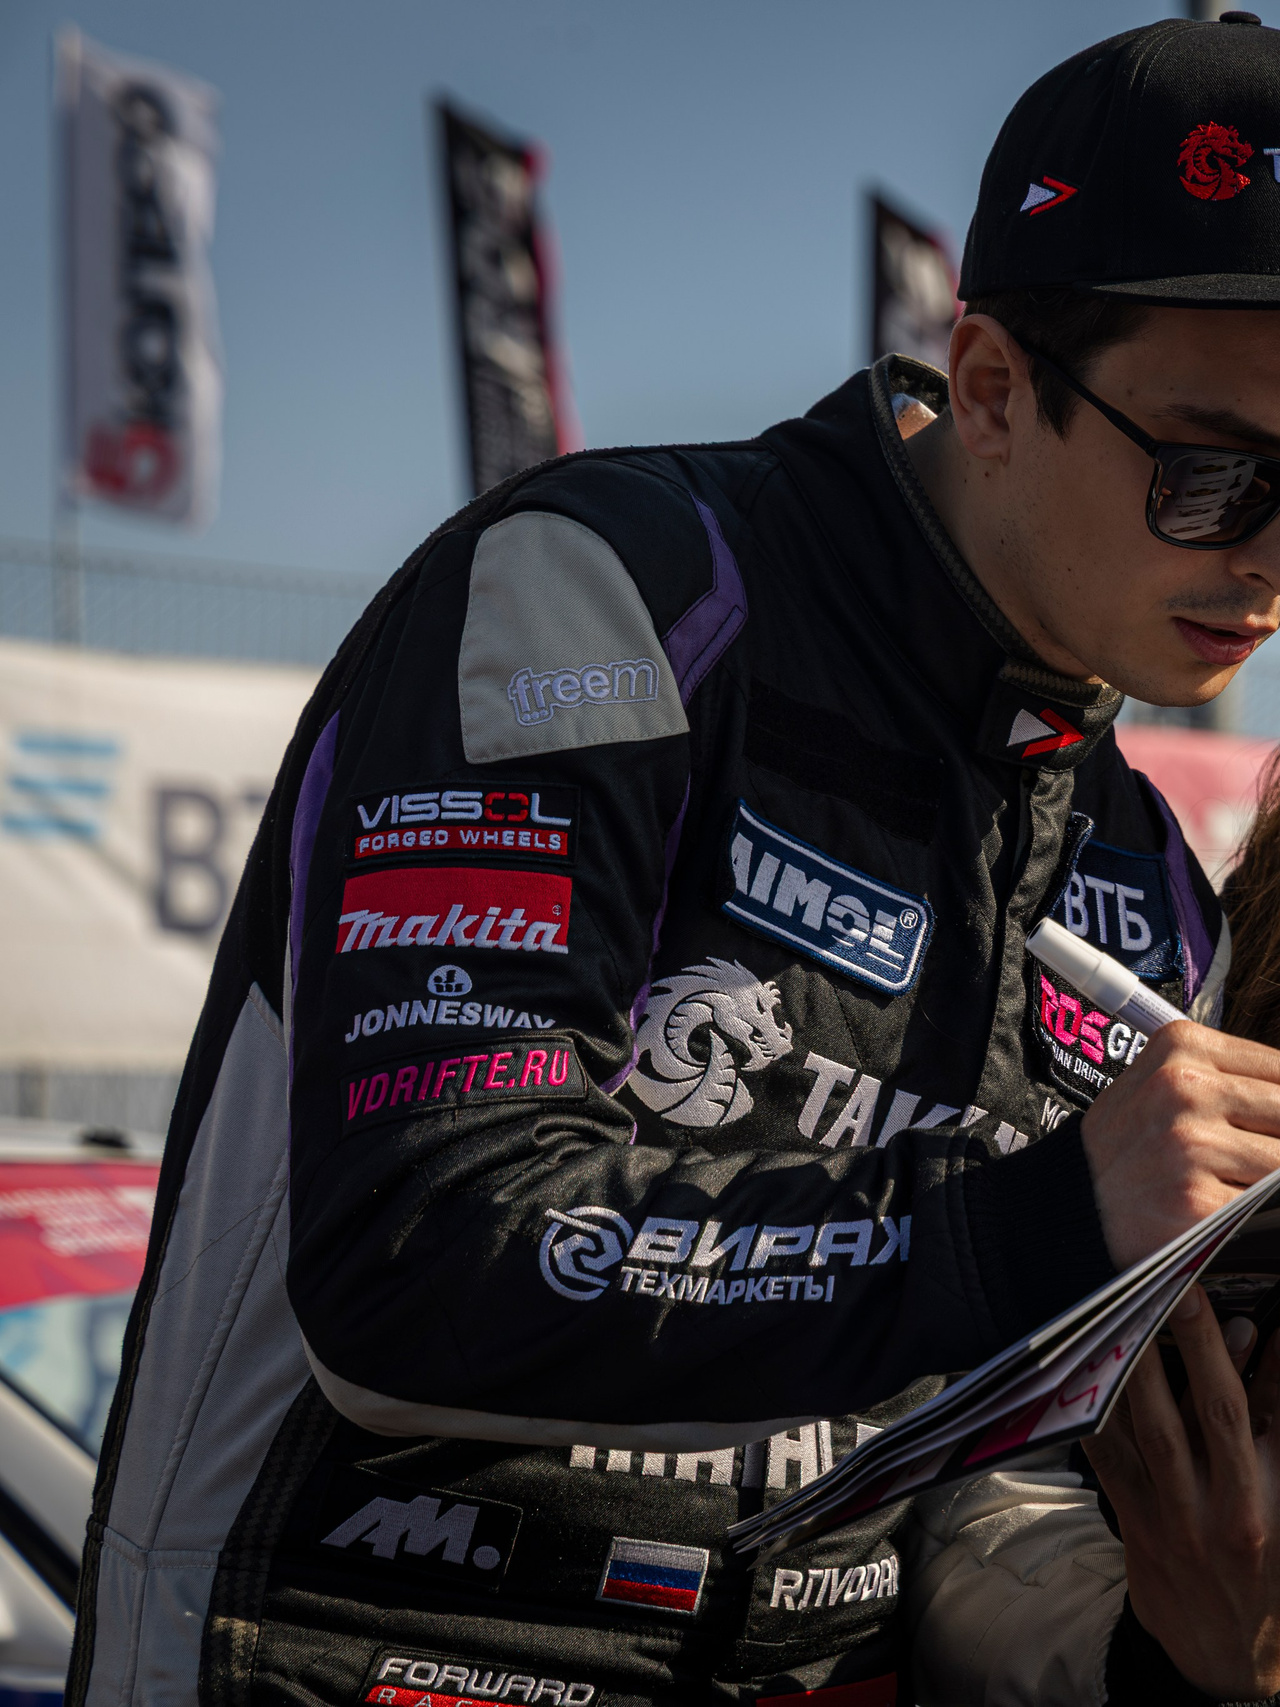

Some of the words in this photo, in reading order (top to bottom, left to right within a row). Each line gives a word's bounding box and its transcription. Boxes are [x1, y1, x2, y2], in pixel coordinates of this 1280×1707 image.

[512, 661, 655, 716] freem
[357, 790, 571, 829] VISSOL
[358, 829, 449, 853] FORGED
[459, 829, 562, 851] WHEELS
[1065, 871, 1152, 951] ВТБ
[347, 1049, 570, 1121] VDRIFTE.RU
[1073, 1057, 1106, 1089] DRIFT
[620, 1266, 835, 1305] ТЕХМАРКЕТЫ
[377, 1657, 595, 1707] FORWARD
